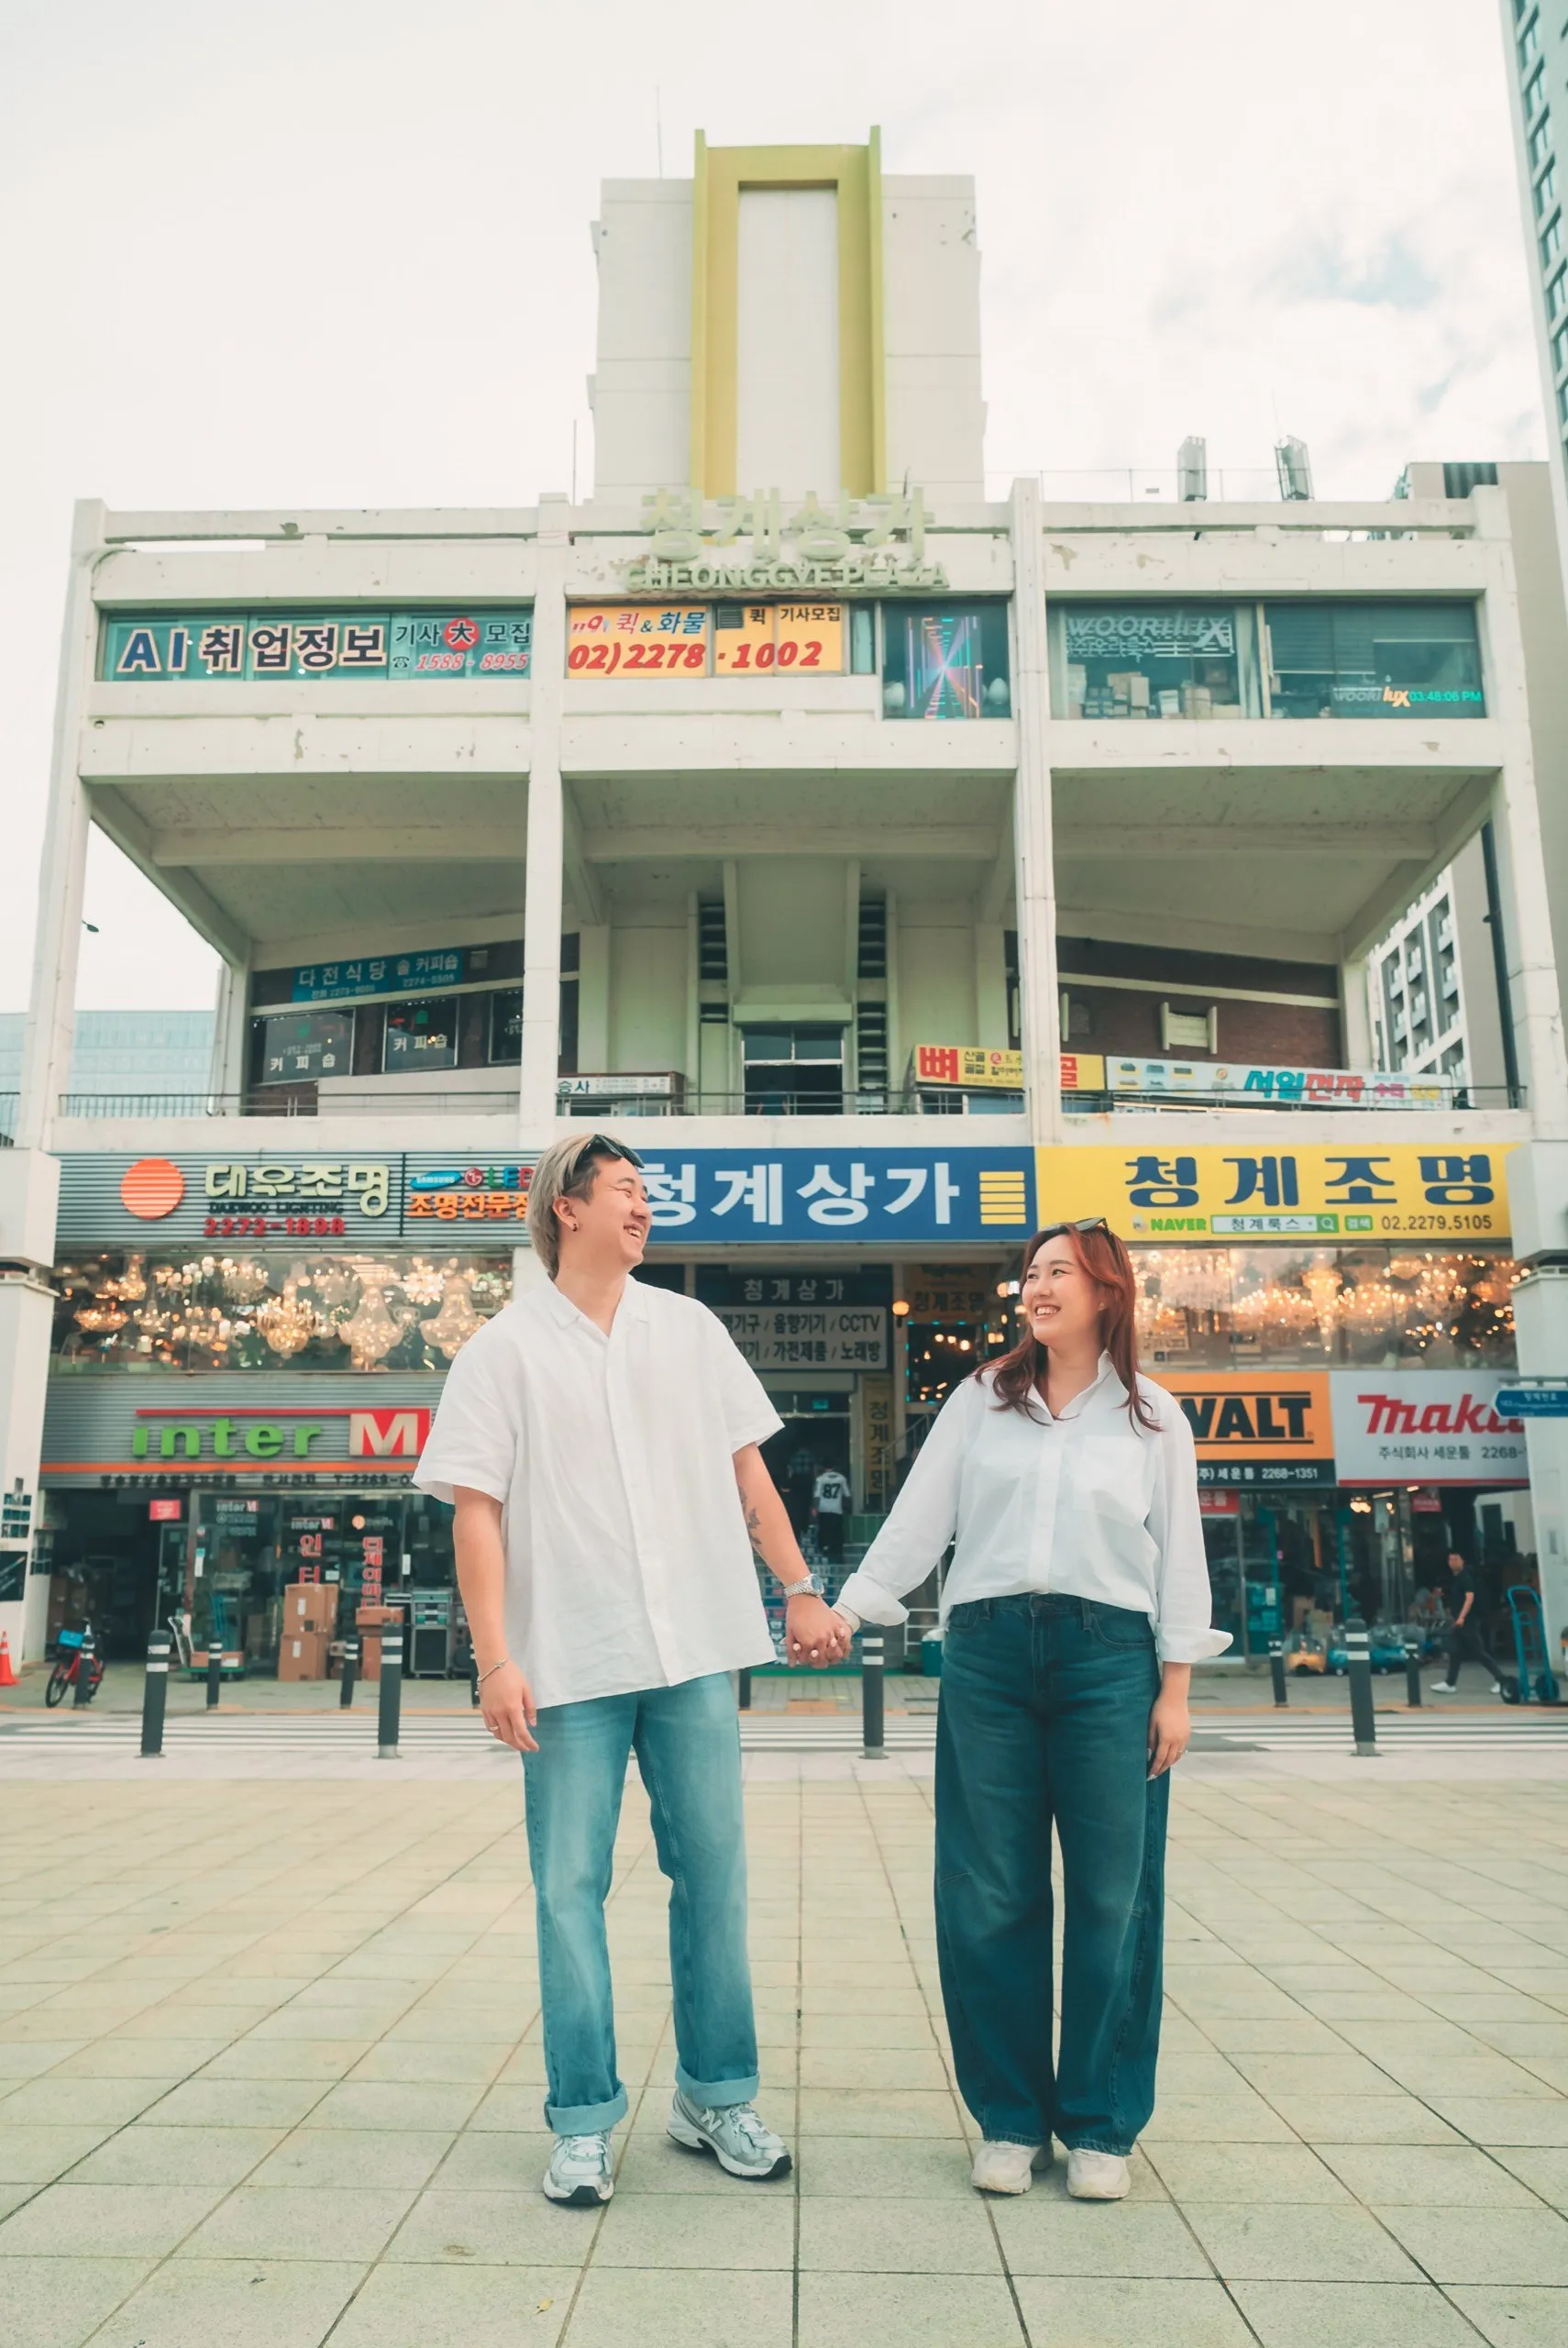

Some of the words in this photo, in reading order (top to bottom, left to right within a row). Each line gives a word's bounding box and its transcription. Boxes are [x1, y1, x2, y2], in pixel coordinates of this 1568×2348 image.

[640, 487, 934, 561] 청계상가
[749, 607, 766, 625] 퀵
[780, 607, 841, 622] 기사모집
[394, 623, 441, 645] 기사
[484, 622, 532, 645] 모집
[116, 627, 189, 672] AI
[199, 623, 388, 672] 취업정보
[1461, 690, 1484, 703] PM
[415, 954, 458, 973] 커피숍
[393, 1034, 449, 1053] 커피숍
[269, 1053, 337, 1071] 커피숍
[1243, 1070, 1367, 1102] 서일전자
[204, 1165, 389, 1217] 대우조명
[1124, 1154, 1496, 1208] 청계조명
[641, 1162, 960, 1226] 청계상가
[204, 1216, 345, 1236] 2272-1898
[1149, 1217, 1209, 1232] NAVER
[1381, 1213, 1494, 1232] 02.2279.5105
[744, 1279, 845, 1301] 청계상가
[773, 1312, 825, 1334] 음향기기
[838, 1313, 881, 1333] CCTV
[773, 1340, 827, 1362] 가전제품
[841, 1340, 881, 1362] 노래방
[132, 1417, 322, 1457] inter
[349, 1412, 420, 1456] M
[1378, 1445, 1429, 1460] 주식회사
[822, 1483, 841, 1500] 87
